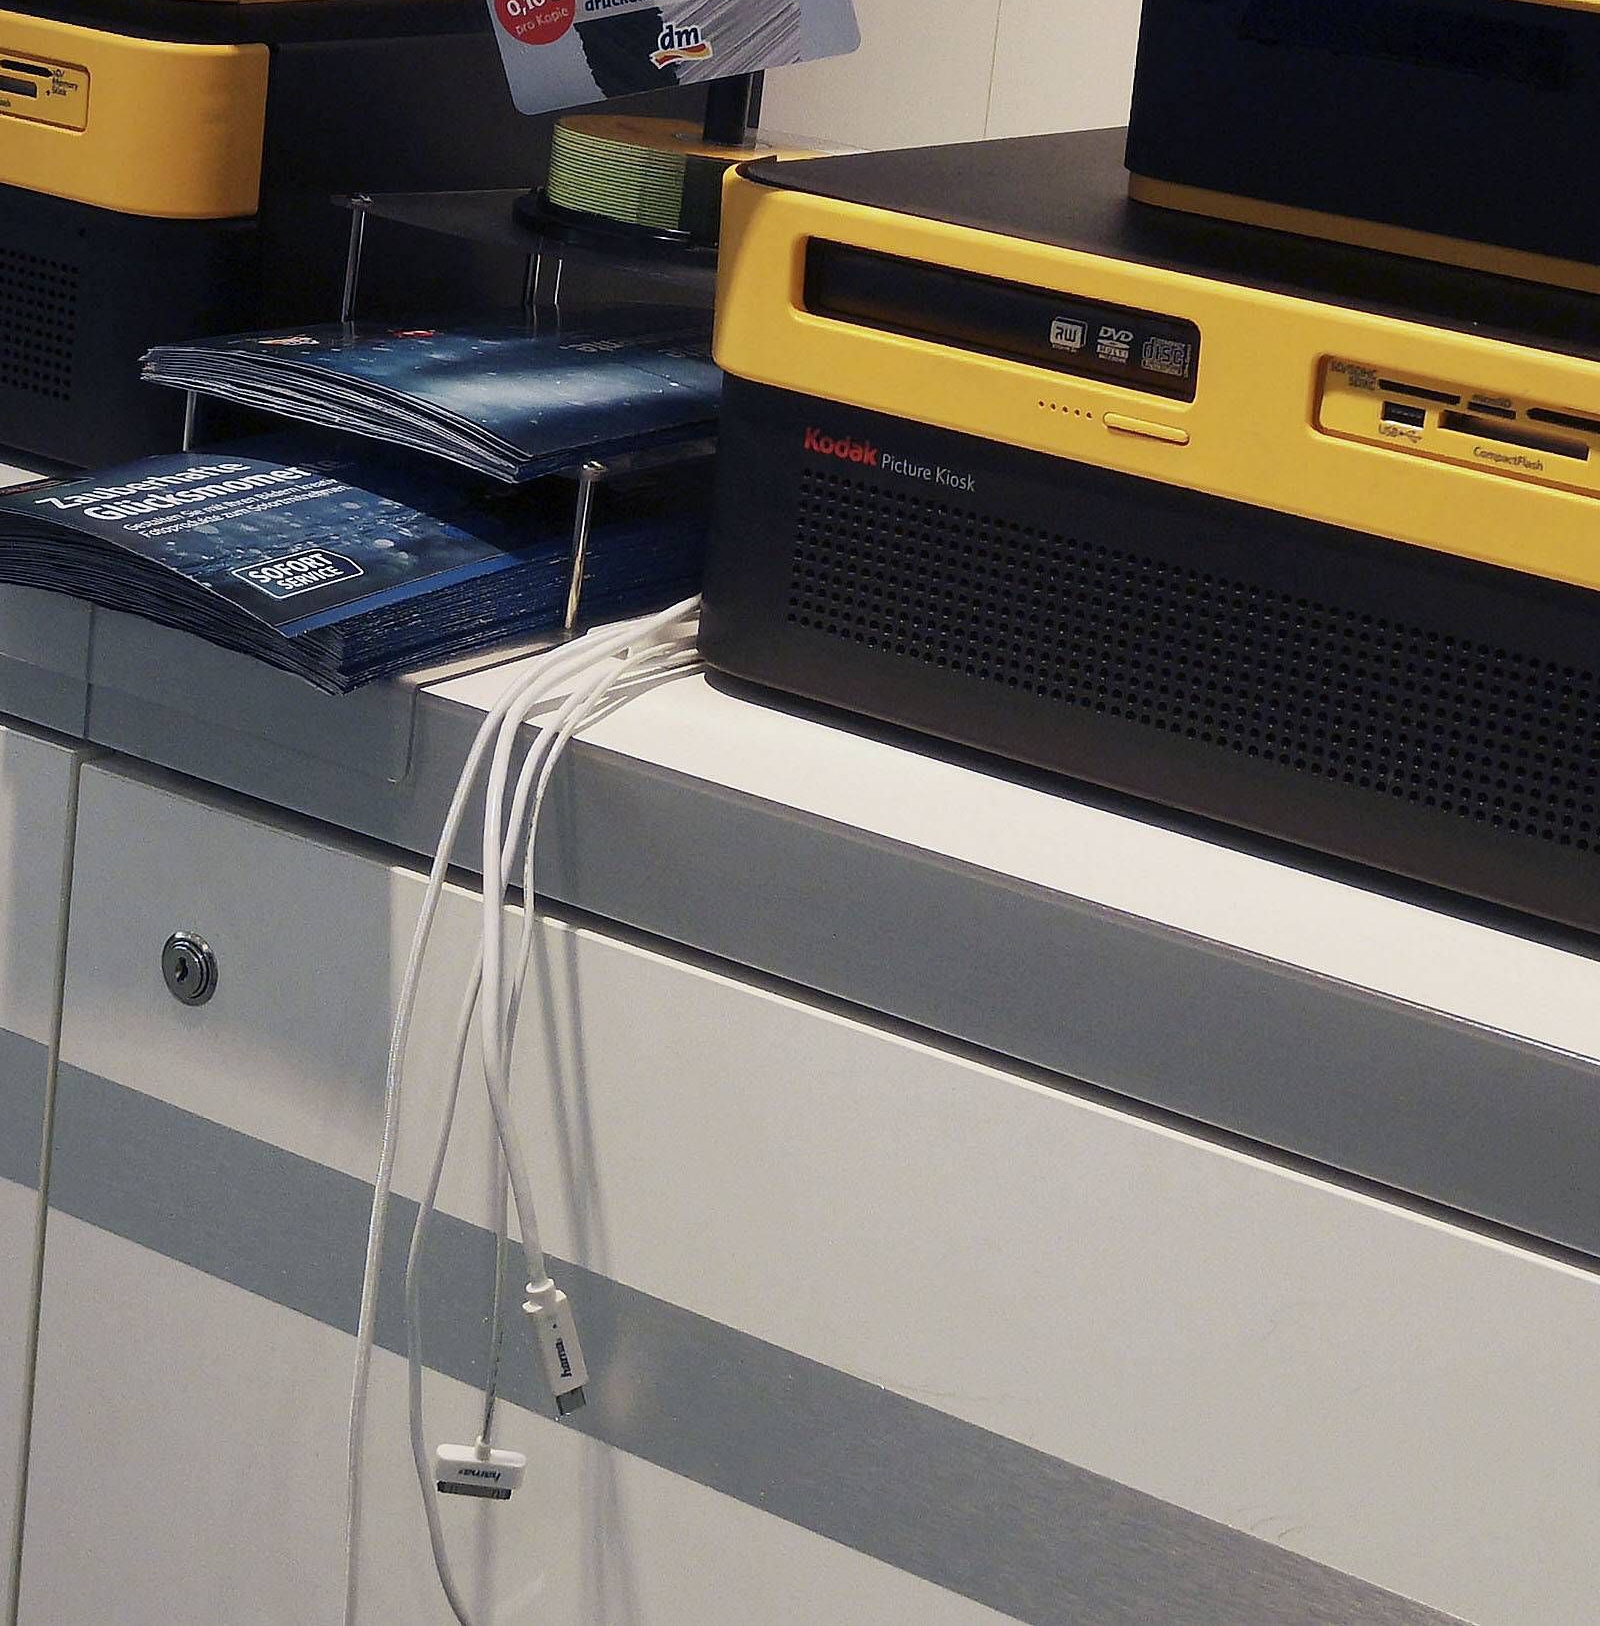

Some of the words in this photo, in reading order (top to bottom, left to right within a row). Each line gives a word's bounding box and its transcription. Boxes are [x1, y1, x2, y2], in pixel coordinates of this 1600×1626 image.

[660, 25, 700, 49] dm
[1099, 326, 1134, 341] DVD
[803, 425, 878, 466] Kodak
[882, 449, 930, 480] Picture
[936, 464, 976, 493] Kiosk
[35, 461, 252, 511] Zauberhafte
[248, 552, 333, 584] SOFORT
[276, 565, 343, 590] SERVICE
